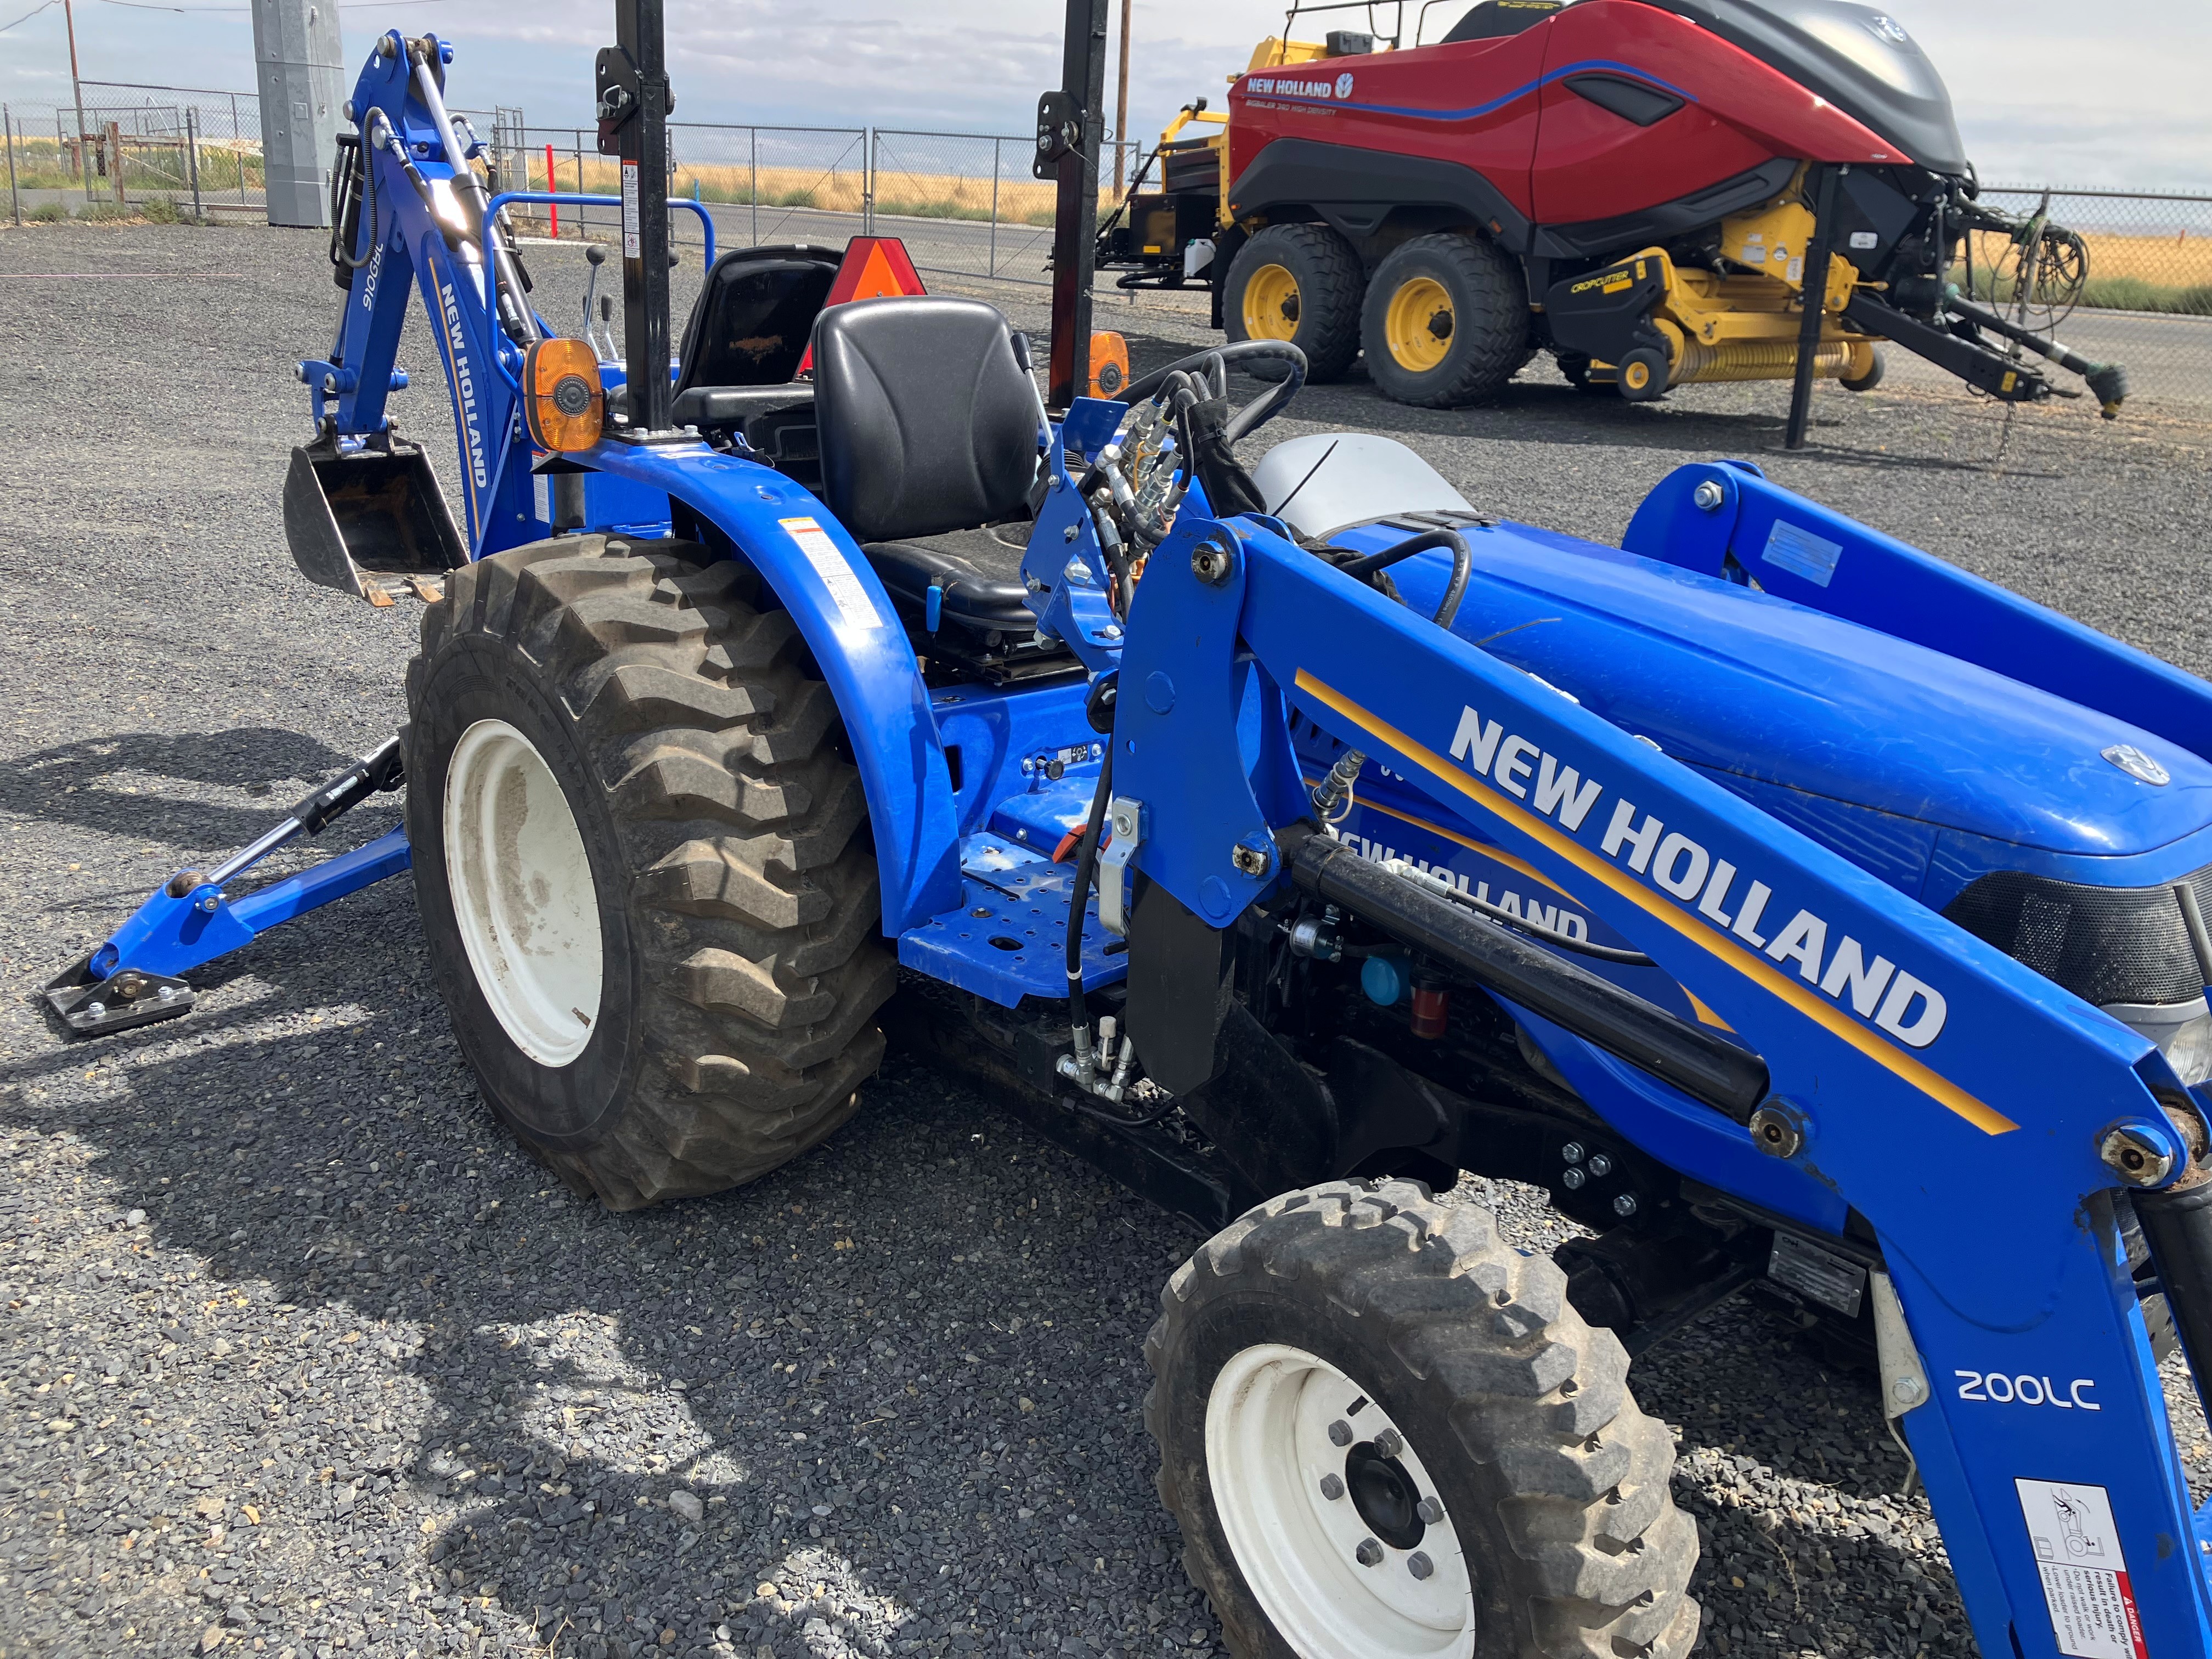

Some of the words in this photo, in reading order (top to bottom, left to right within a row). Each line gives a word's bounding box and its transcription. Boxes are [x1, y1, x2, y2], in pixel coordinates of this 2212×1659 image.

[1247, 78, 1275, 93] NEW
[1276, 80, 1332, 98] HOLLAND
[1571, 270, 1629, 294] CROPCUTTER
[442, 283, 465, 349] NEW
[457, 356, 487, 488] HOLLAND
[1449, 704, 1603, 833] NEW
[1600, 798, 1948, 1049] HOLLAND
[1954, 1370, 2102, 1410] 200LC
[2043, 1567, 2052, 1585] when
[2076, 1583, 2085, 1595] not
[2105, 1573, 2117, 1601] Failure
[2064, 1570, 2074, 1590] under
[2069, 1592, 2081, 1614] raised
[2080, 1596, 2089, 1613] walk
[2084, 1570, 2096, 1601] serious
[2092, 1604, 2103, 1629] injury.
[2058, 1592, 2068, 1613] loader
[2065, 1624, 2078, 1650] ground
[2084, 1614, 2091, 1622] or
[2094, 1571, 2106, 1596] result
[2104, 1608, 2115, 1632] death
[2111, 1634, 2117, 1644] or
[2113, 1604, 2120, 1612] to
[2087, 1624, 2096, 1641] work
[2116, 1615, 2129, 1645] comply
[2127, 1607, 2142, 1642] DANGER
[2124, 1647, 2133, 1659] wil
